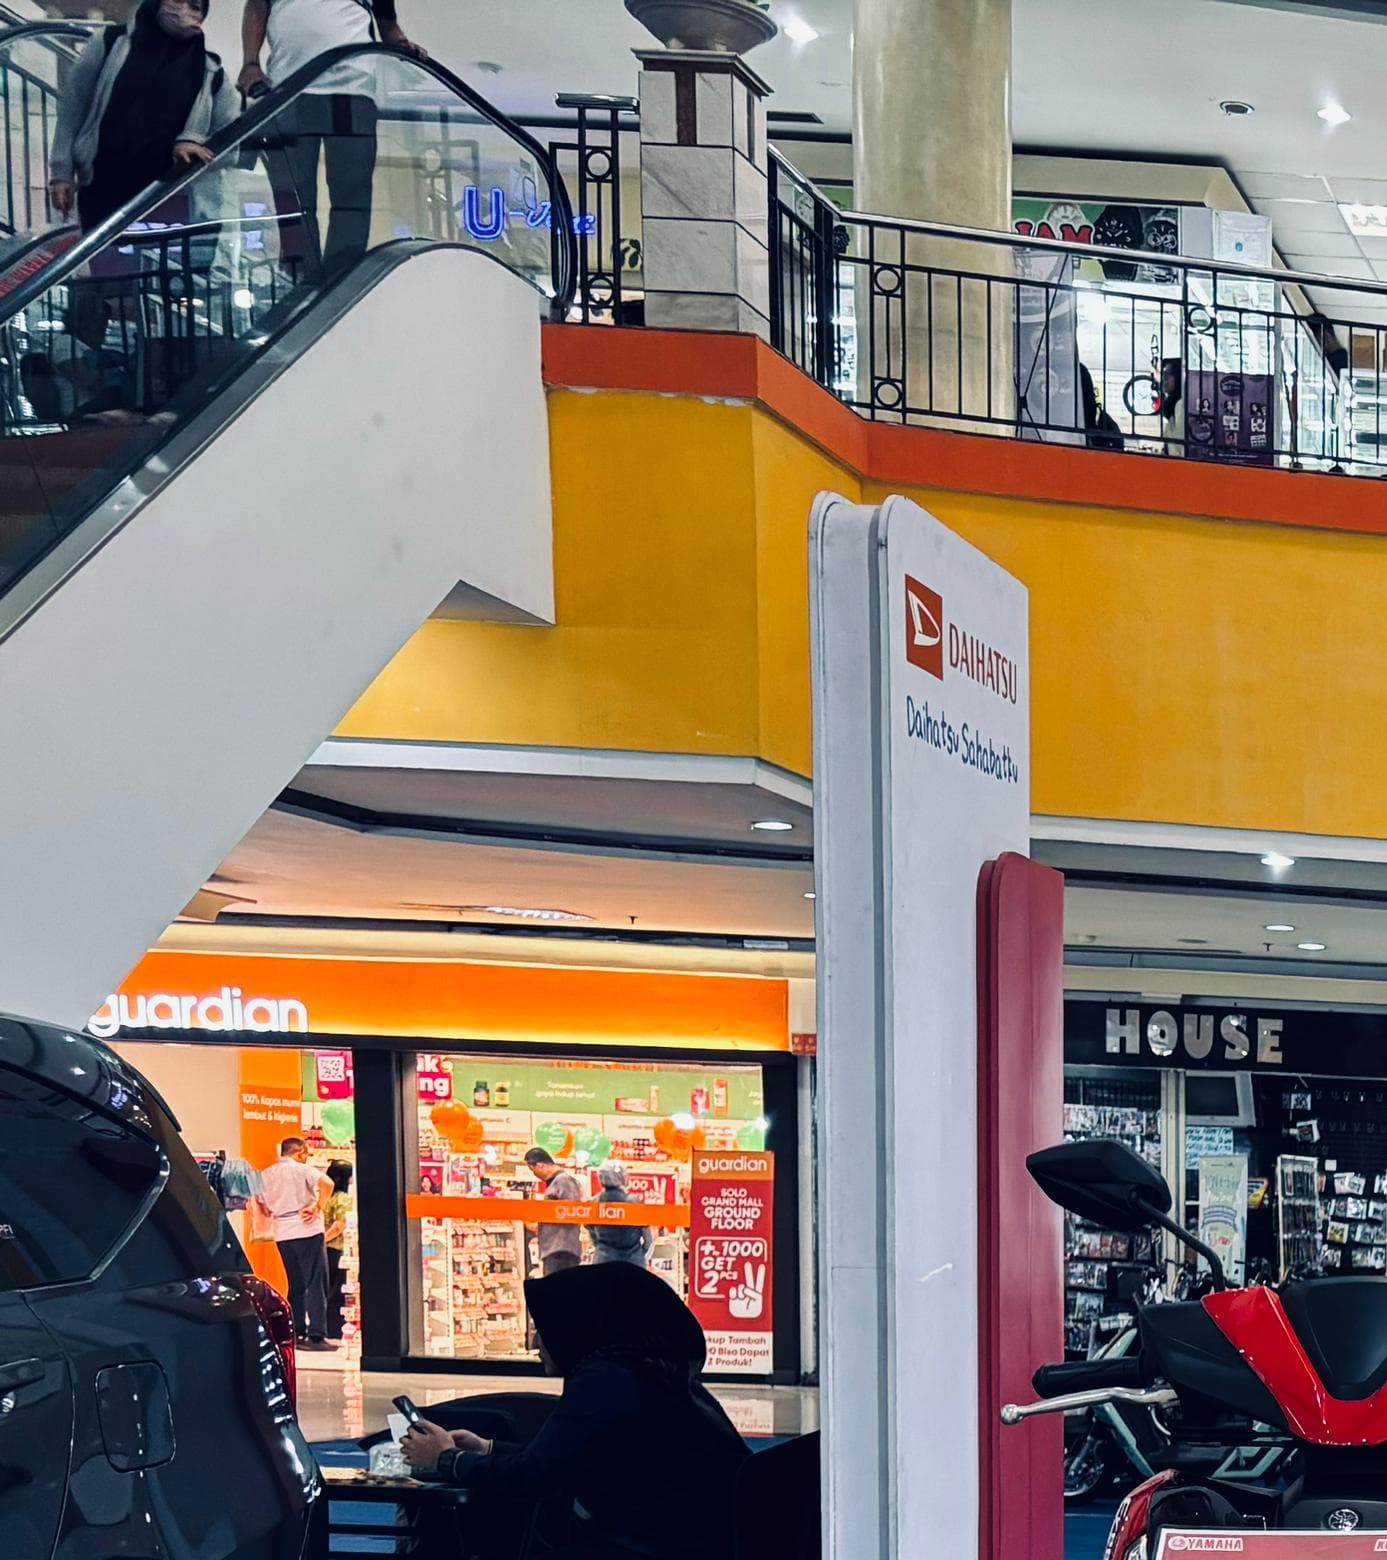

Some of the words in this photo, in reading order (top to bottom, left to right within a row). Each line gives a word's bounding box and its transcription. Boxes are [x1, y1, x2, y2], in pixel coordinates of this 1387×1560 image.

[949, 622, 1018, 705] DAIHATSU
[907, 696, 960, 755] Daihatsu
[88, 987, 308, 1038] guardian
[1106, 1008, 1284, 1064] HOUSE
[699, 1157, 768, 1174] guardian
[720, 1188, 748, 1198] SOLO
[701, 1197, 737, 1207] GRAND
[738, 1197, 764, 1207] MALL
[703, 1207, 761, 1219] GROUND
[711, 1218, 754, 1230] FLOOR
[700, 1257, 737, 1270] GET
[728, 1335, 766, 1346] Tambah
[1188, 1537, 1243, 1550] YAMAHA
